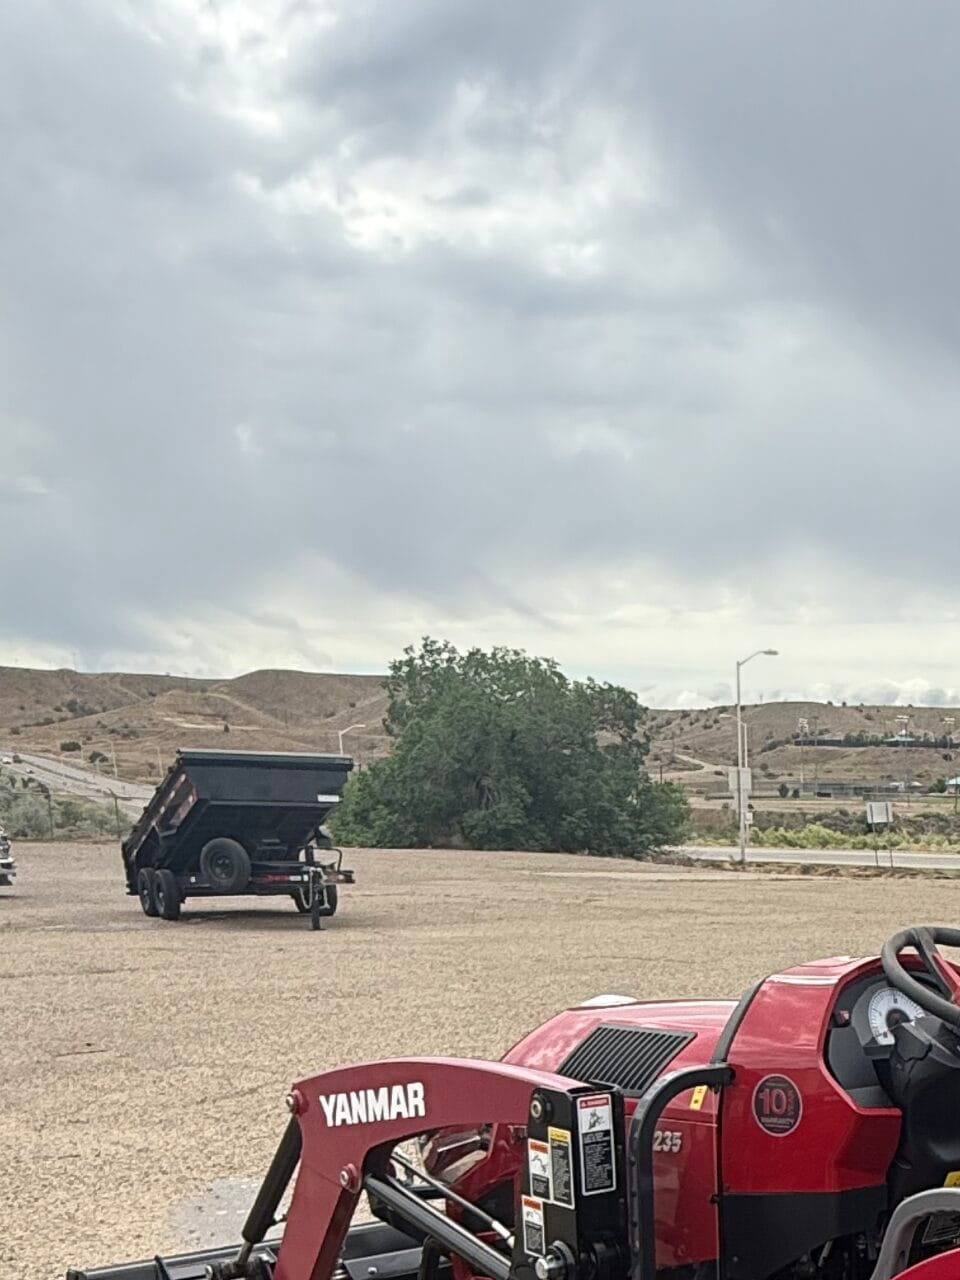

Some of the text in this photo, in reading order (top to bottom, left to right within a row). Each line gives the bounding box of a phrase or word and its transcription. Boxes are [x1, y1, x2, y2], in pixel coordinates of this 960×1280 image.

[319, 1082, 426, 1127] YANMAR
[759, 1088, 787, 1116] 10
[652, 1131, 683, 1153] 235
